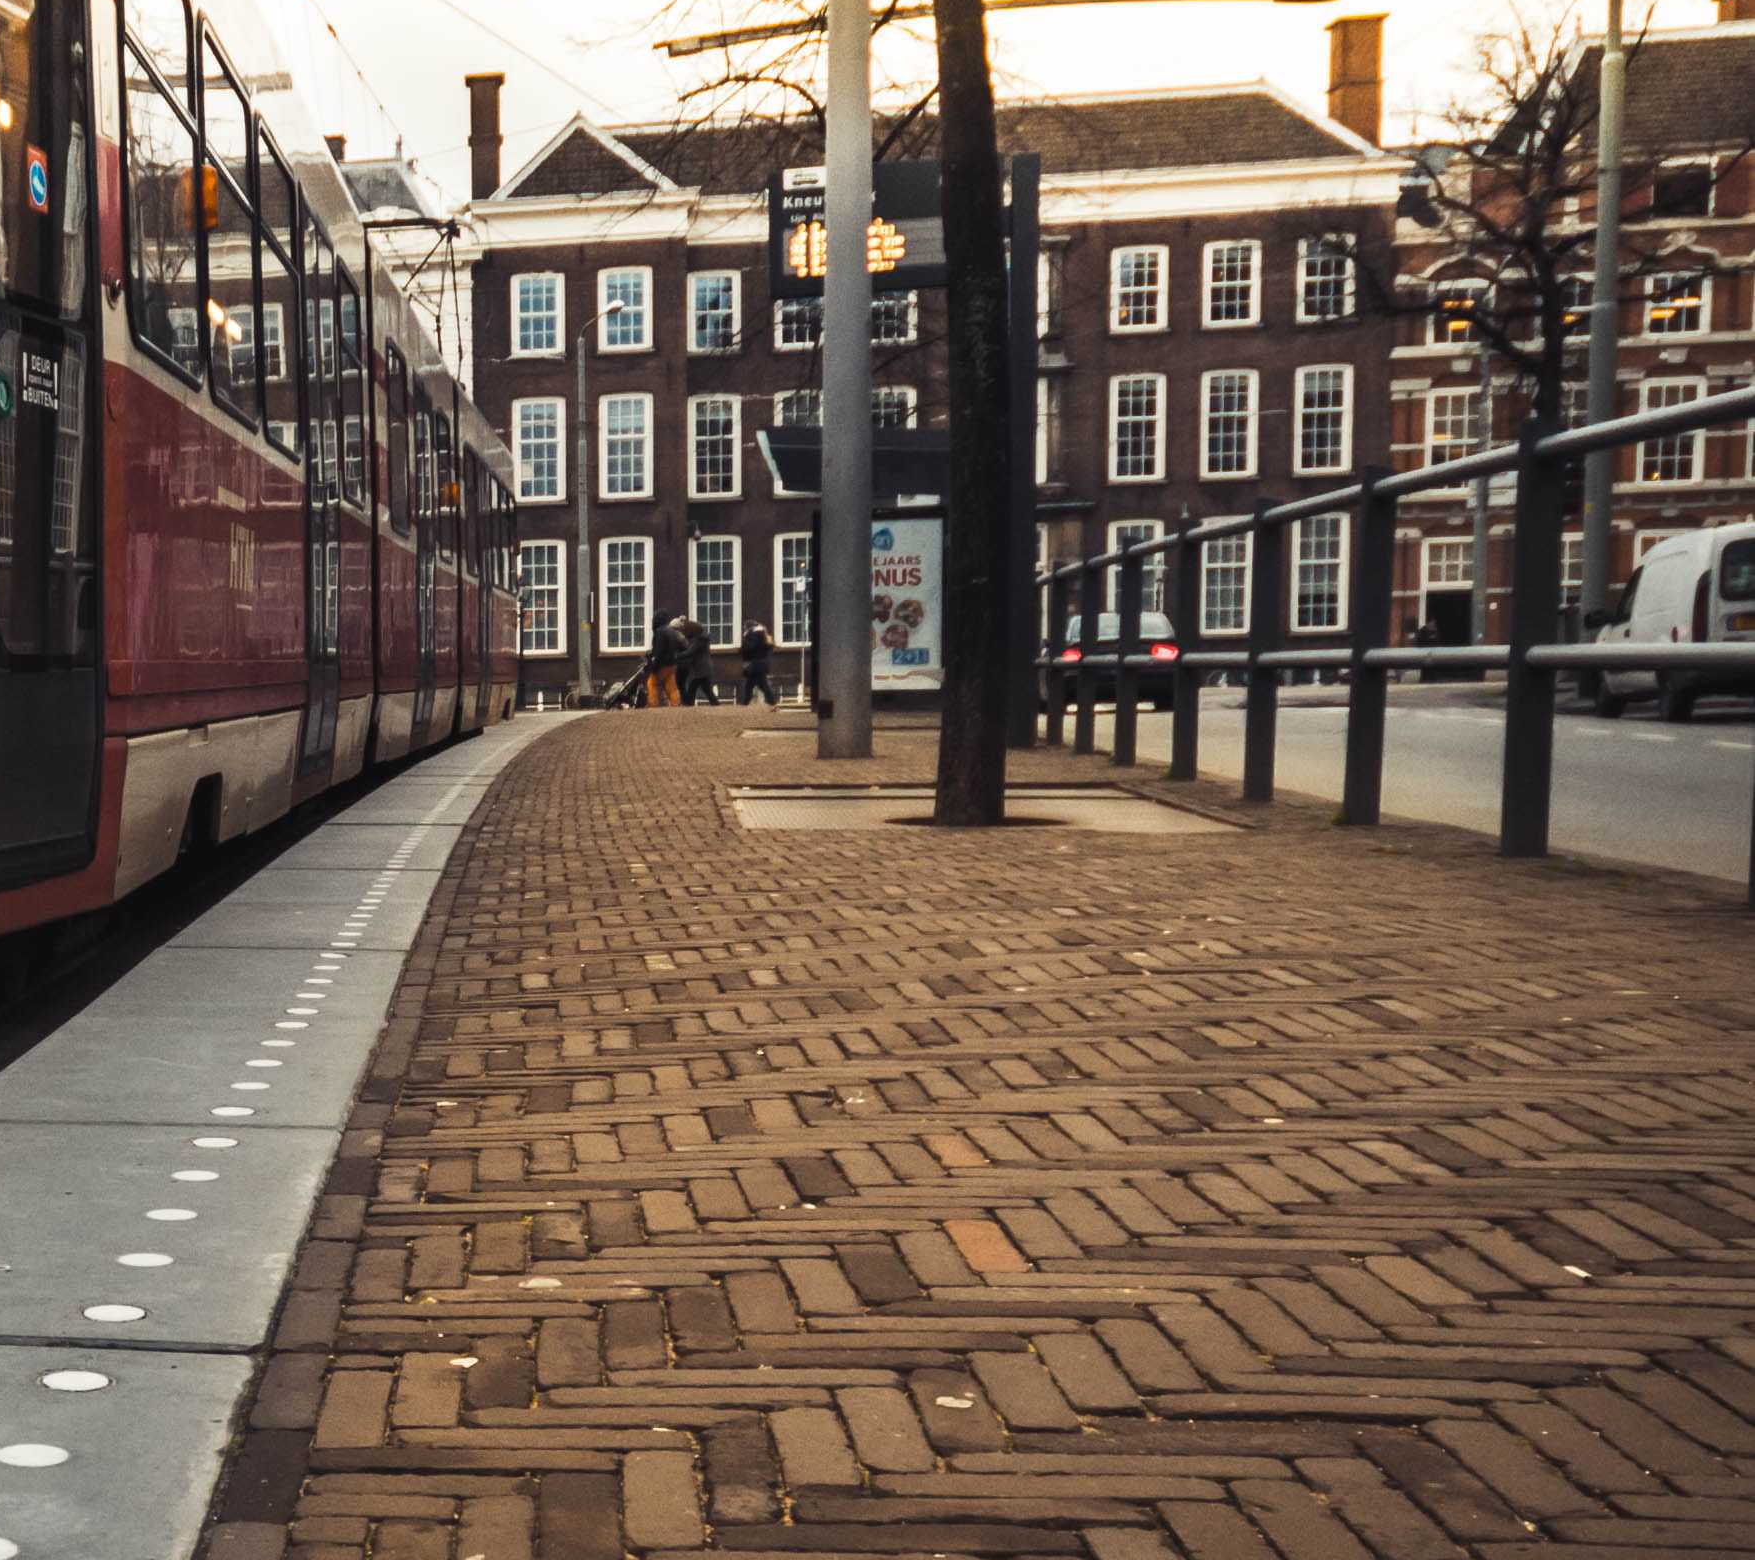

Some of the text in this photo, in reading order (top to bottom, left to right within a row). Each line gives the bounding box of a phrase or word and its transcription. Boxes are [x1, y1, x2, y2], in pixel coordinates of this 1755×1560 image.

[31, 355, 51, 375] DEUR
[28, 386, 54, 408] BUITEN
[873, 555, 922, 566] EJAARS
